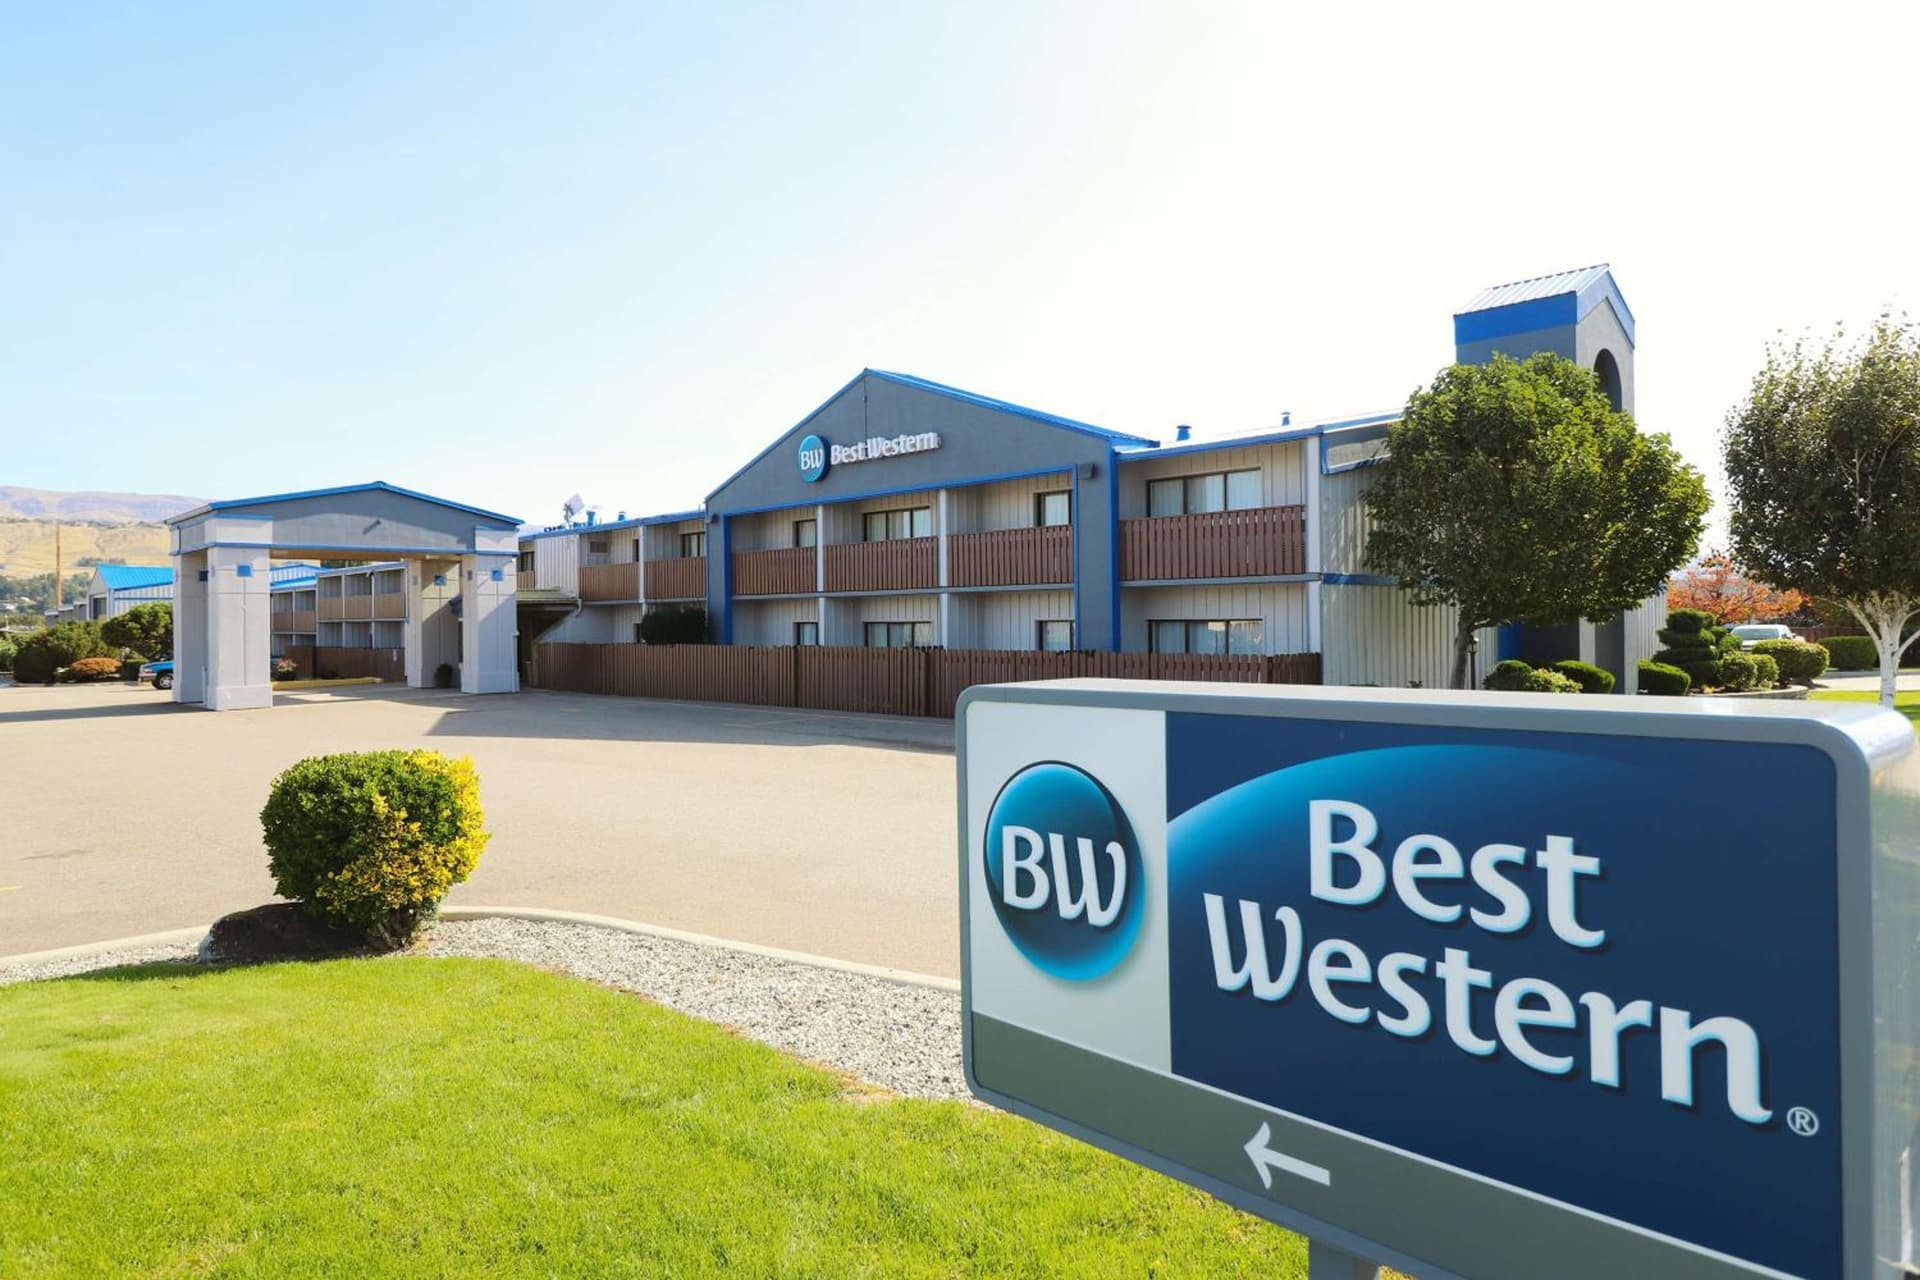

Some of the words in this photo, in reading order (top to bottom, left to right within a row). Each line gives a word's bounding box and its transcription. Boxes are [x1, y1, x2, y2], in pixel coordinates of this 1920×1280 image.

[800, 448, 823, 470] BW
[831, 444, 866, 465] Best
[866, 432, 938, 459] Western
[1001, 825, 1127, 928] BW
[1308, 798, 1604, 948] Best
[1203, 892, 1772, 1124] Western
